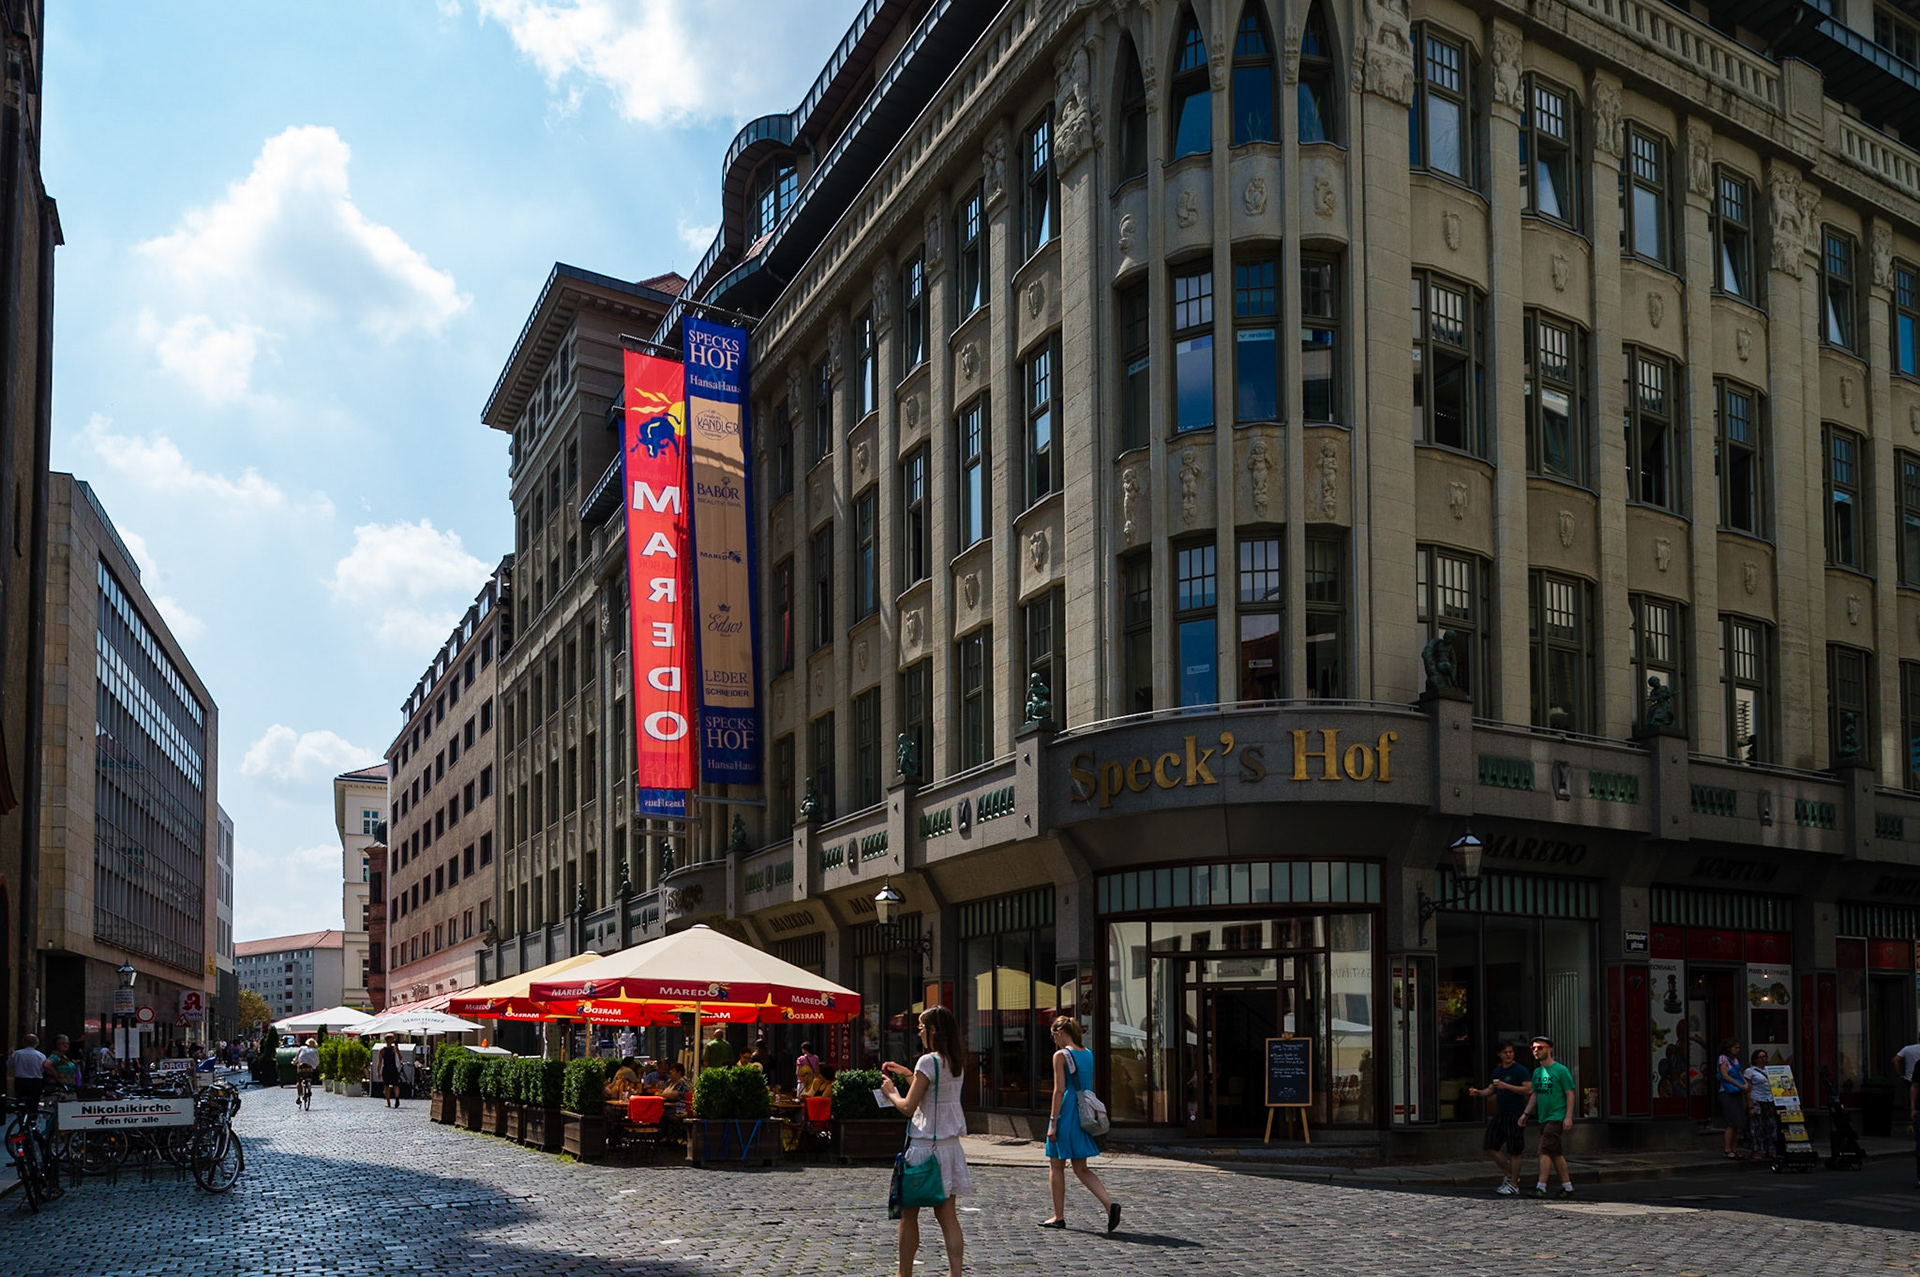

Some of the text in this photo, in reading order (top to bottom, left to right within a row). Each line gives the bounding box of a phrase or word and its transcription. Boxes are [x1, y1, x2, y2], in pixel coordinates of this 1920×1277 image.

[688, 329, 740, 351] SPECKS
[689, 342, 740, 371] HOF
[690, 373, 742, 394] HansaHaus
[697, 482, 741, 500] BABOR
[705, 669, 749, 684] LEDER
[705, 687, 749, 697] SCHNEIDER
[705, 716, 755, 730] SPECKS
[706, 728, 755, 750] HOF
[1288, 728, 1398, 783] Hof
[768, 909, 815, 933] MAREDO
[552, 986, 590, 997] MAREDO
[659, 985, 719, 997] MAREDO
[465, 1003, 491, 1011] MAREDO
[791, 994, 829, 1006] MAREDO
[81, 1103, 172, 1115] Nikolaikirche
[94, 1115, 159, 1126] offen für alle
